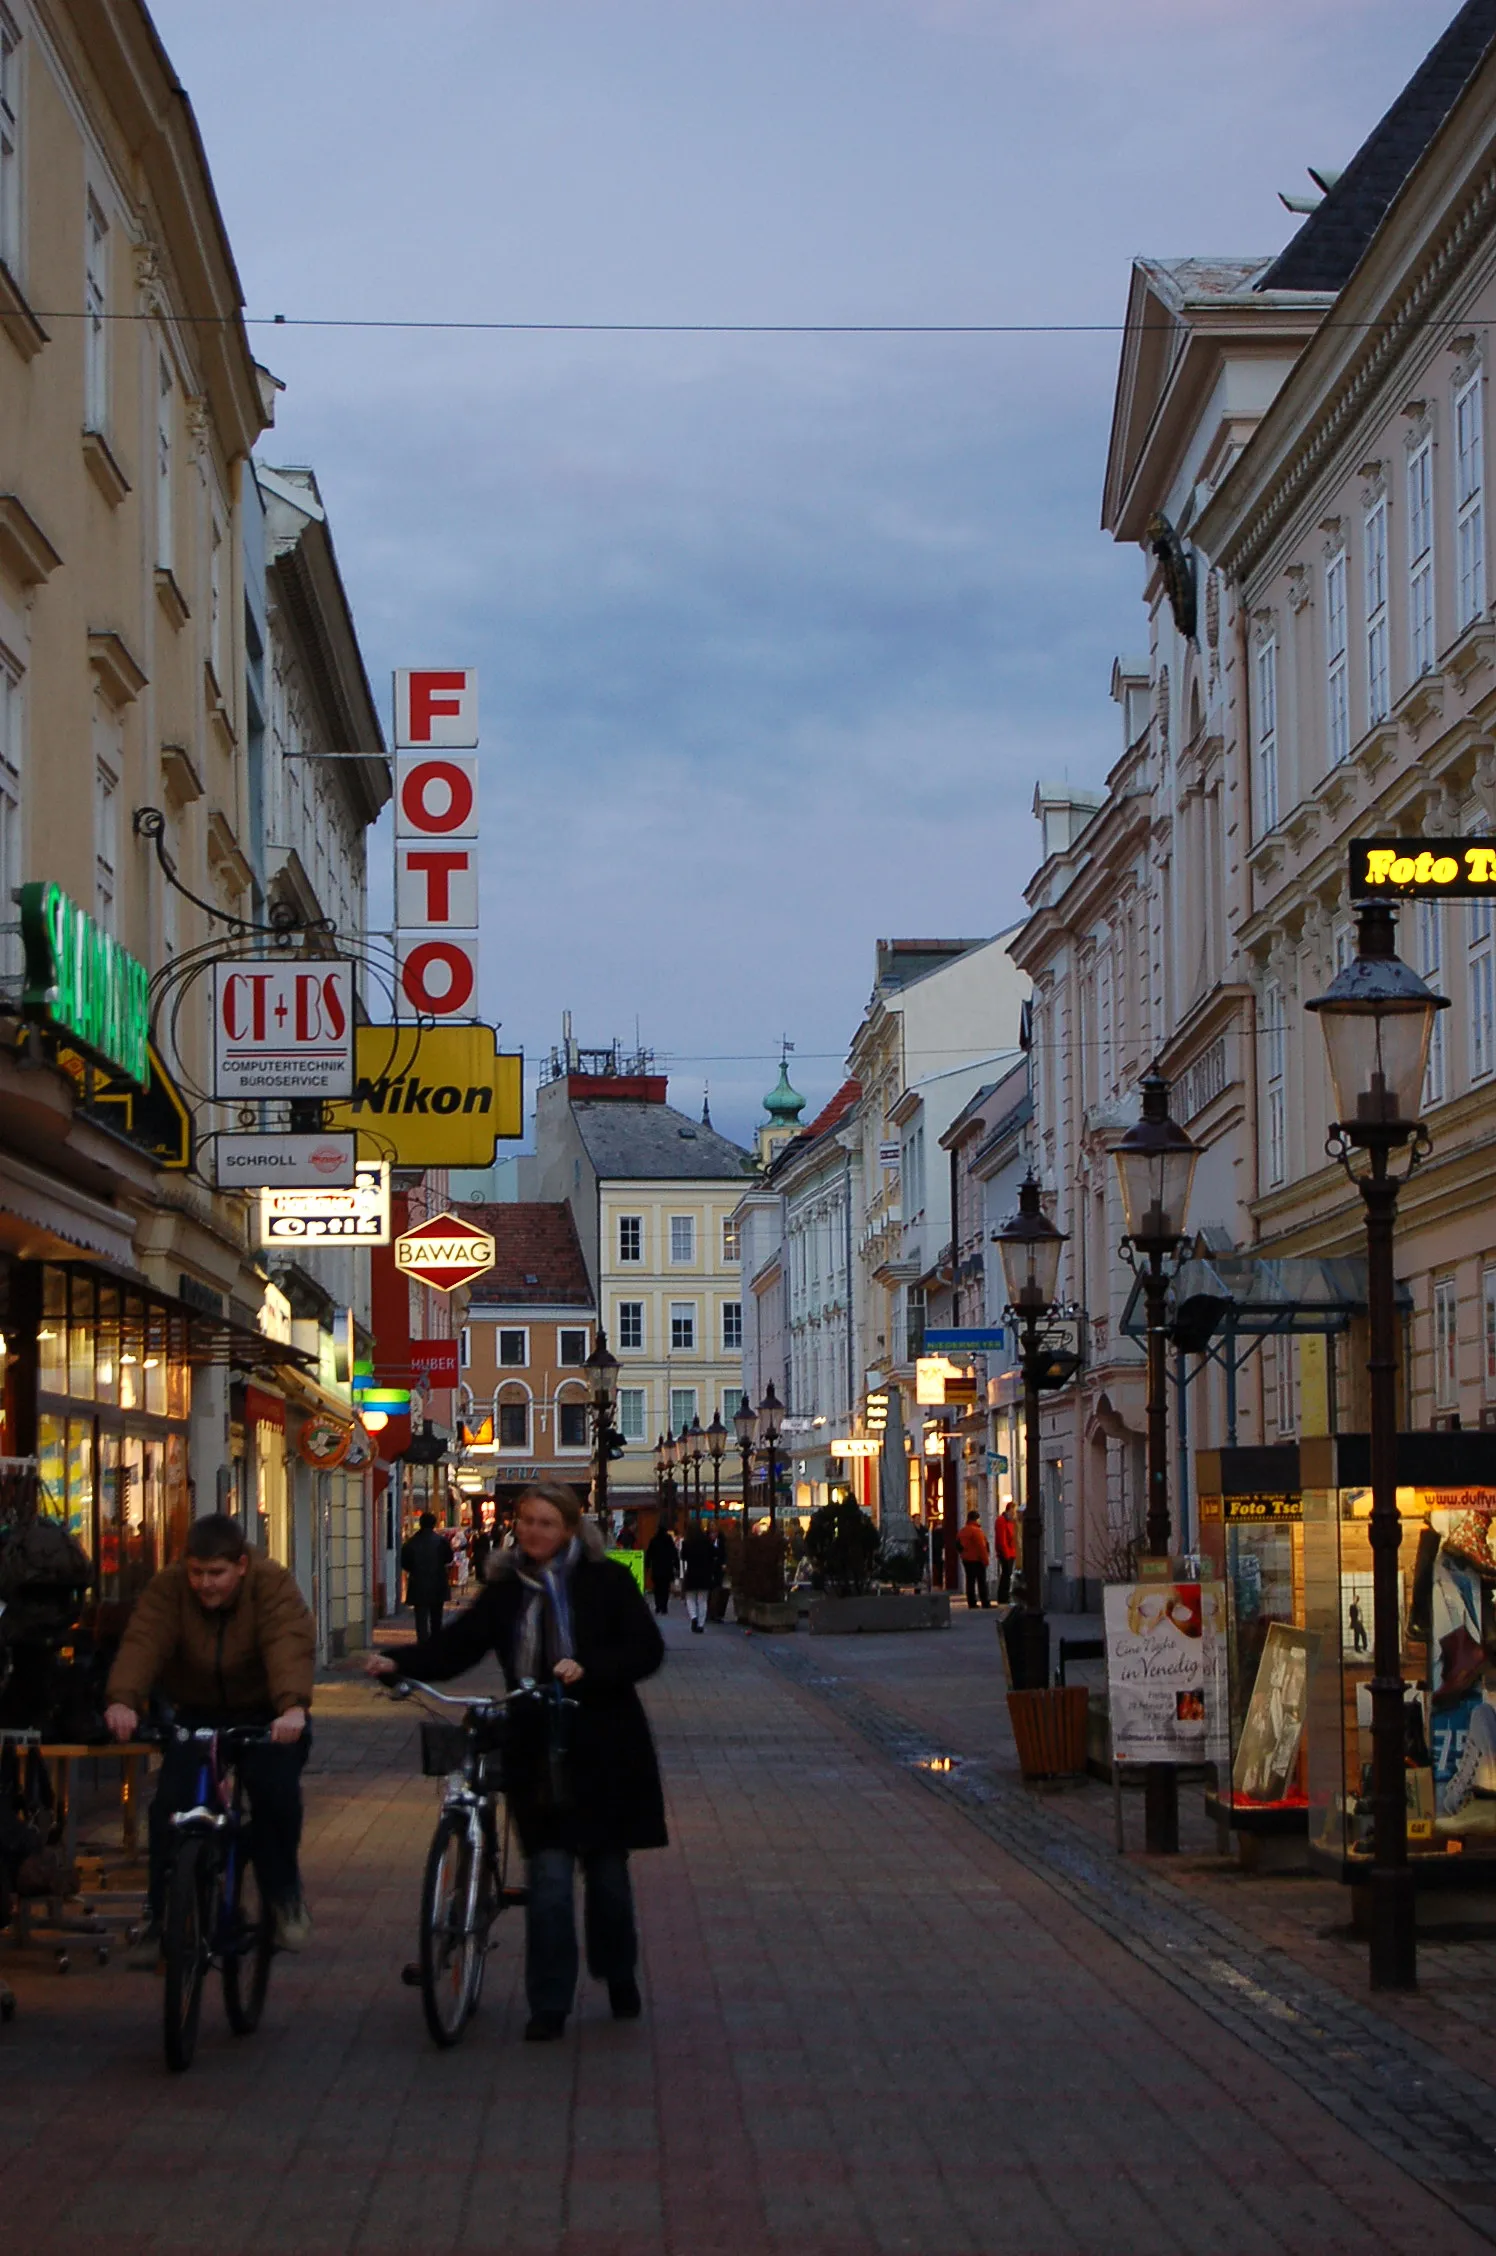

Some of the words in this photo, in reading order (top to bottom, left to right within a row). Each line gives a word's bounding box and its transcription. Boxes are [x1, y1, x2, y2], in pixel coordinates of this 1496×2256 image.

[402, 672, 474, 1015] FOTO
[1365, 849, 1459, 885] Foto
[222, 1061, 345, 1072] COMPUTERTECHNIK
[352, 1077, 493, 1115] Nikon
[226, 1155, 297, 1167] SCHROLL
[272, 1216, 379, 1236] Optik
[399, 1241, 491, 1263] BAWAG
[410, 1356, 456, 1370] HUBER
[1230, 1502, 1266, 1516] Foto
[1140, 1651, 1199, 1682] Venedig
